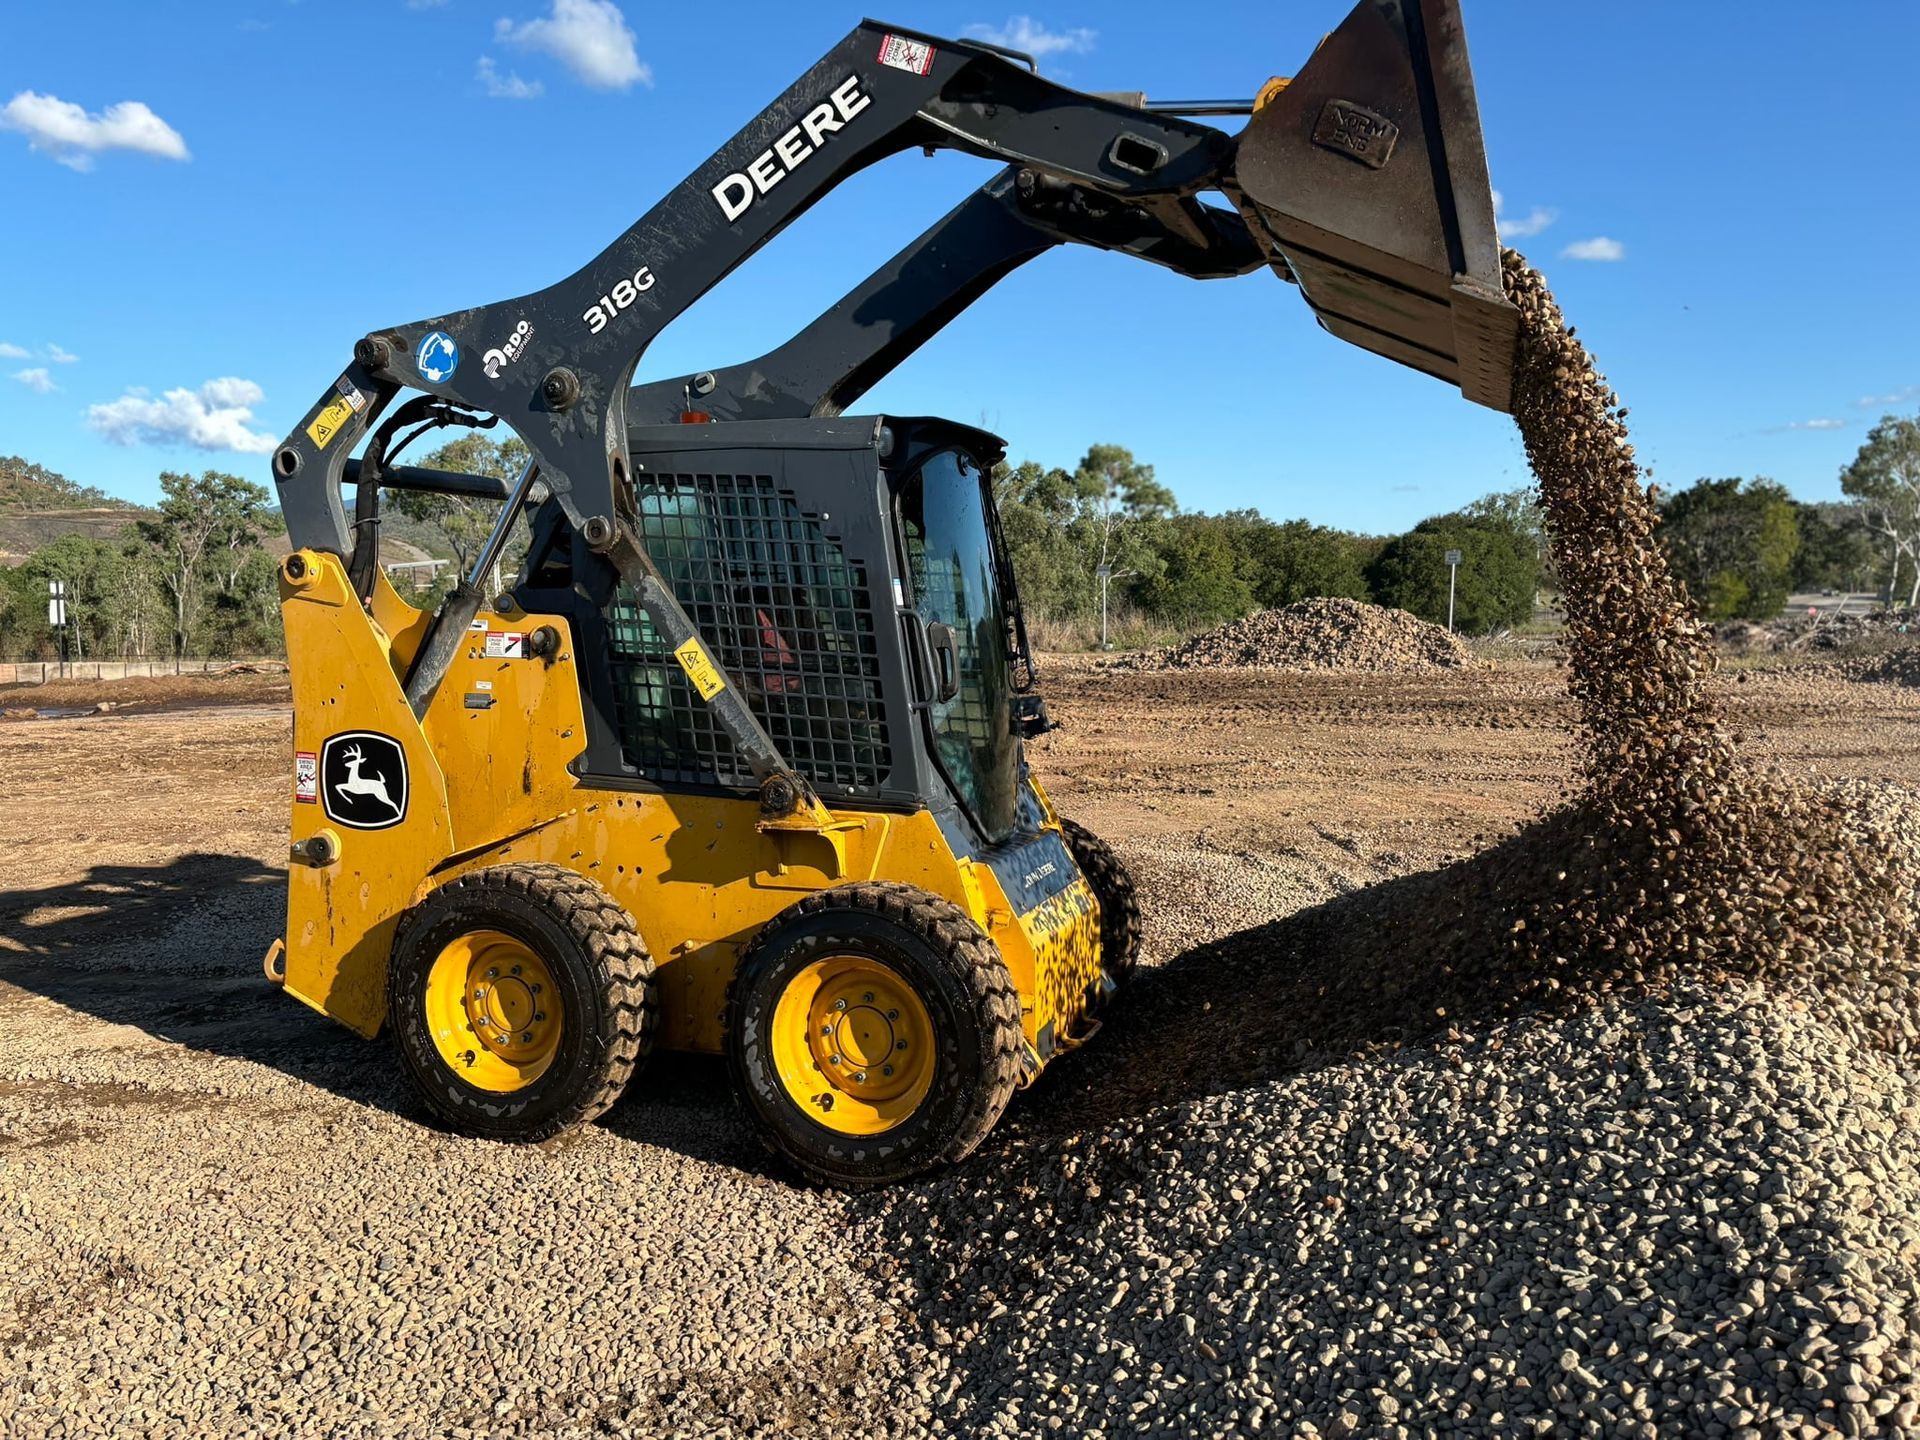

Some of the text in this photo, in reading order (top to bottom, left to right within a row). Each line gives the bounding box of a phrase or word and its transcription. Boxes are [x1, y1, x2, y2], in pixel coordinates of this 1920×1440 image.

[712, 75, 871, 222] DEERE
[583, 266, 656, 334] 318G
[502, 320, 529, 358] RDO
[511, 326, 535, 363] EQUIPMENT
